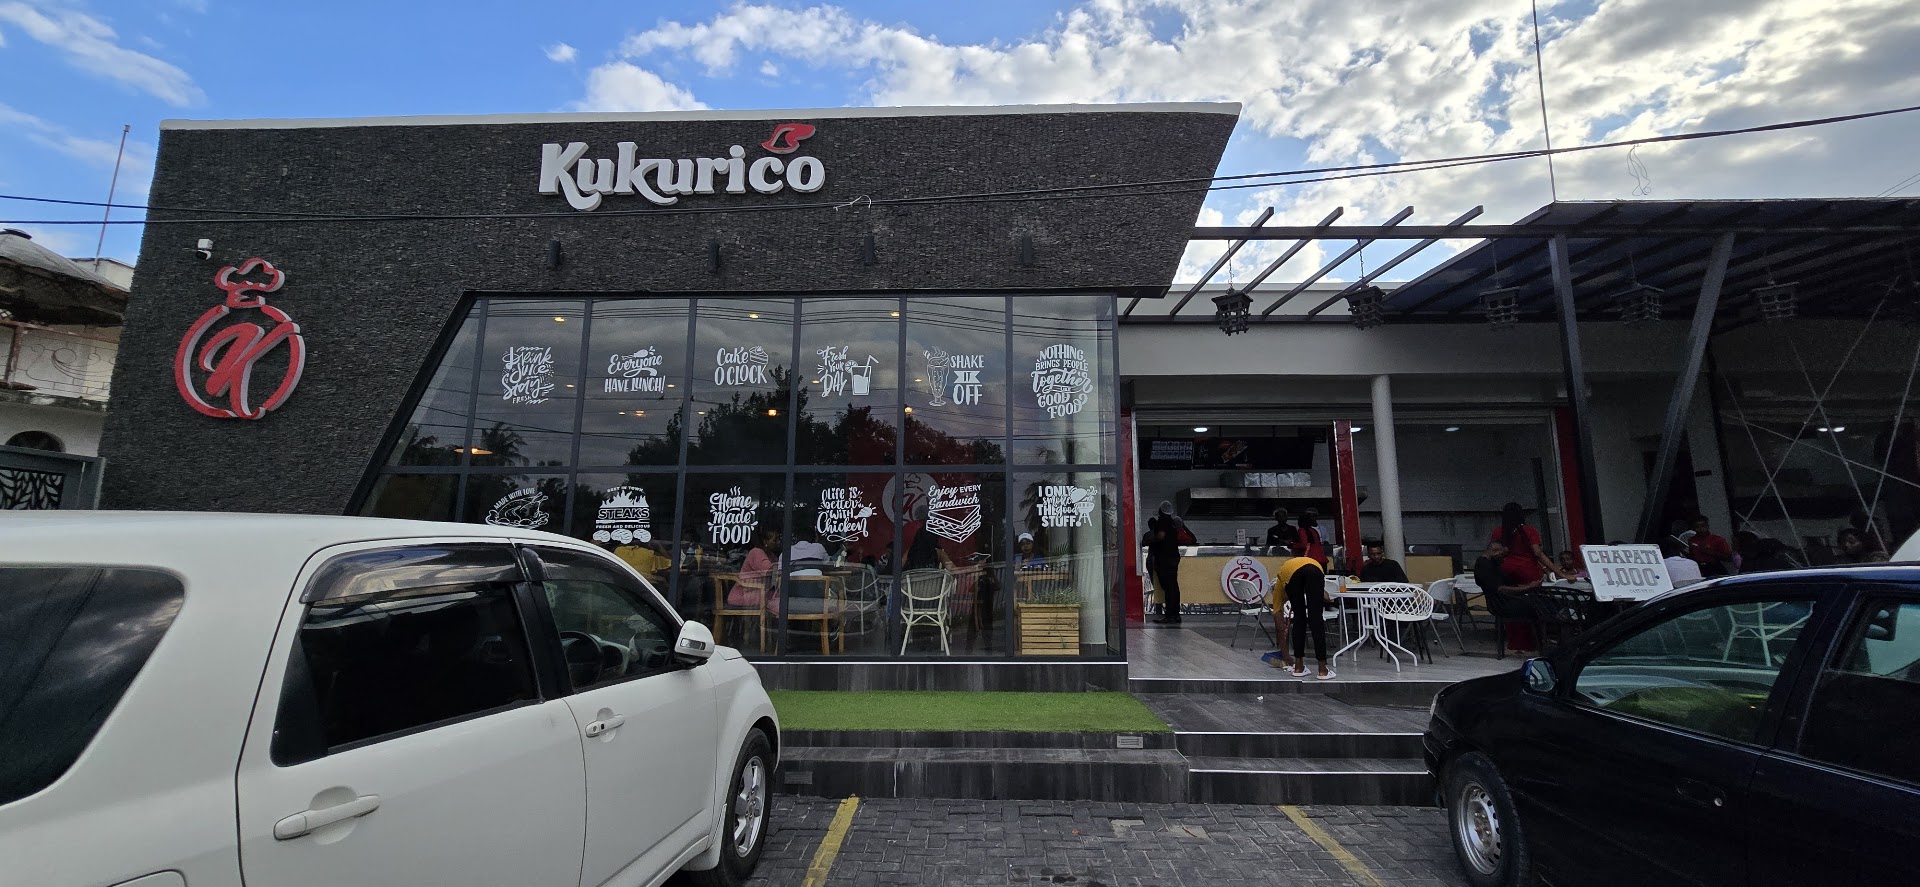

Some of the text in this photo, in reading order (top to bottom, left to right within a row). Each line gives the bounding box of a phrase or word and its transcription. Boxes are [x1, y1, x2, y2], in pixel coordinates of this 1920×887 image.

[538, 141, 826, 212] Kukurico
[949, 354, 985, 369] SHAKE
[1039, 343, 1084, 361] NOTHING
[607, 353, 663, 378] Everyone
[1035, 359, 1089, 372] BRINGS PEOPLE
[604, 375, 666, 394] HAVE LUNCH!
[819, 369, 848, 398] DAY
[963, 371, 972, 382] IT
[1030, 367, 1094, 394] Together
[501, 373, 554, 400] Stay
[952, 383, 983, 406] OFF
[1036, 392, 1071, 408] GOOD
[1047, 393, 1088, 419] FOOD
[493, 487, 536, 510] MADE WITH LOVE
[927, 484, 982, 500] Enjoy EVERY
[928, 492, 980, 510] Sandwich
[1038, 485, 1075, 498] I ONLY
[709, 492, 752, 513] Home
[1036, 503, 1057, 516] THE
[597, 507, 650, 520] STEAKS
[712, 508, 751, 526] made
[816, 511, 869, 538] Chicken
[712, 524, 751, 545] FOOD
